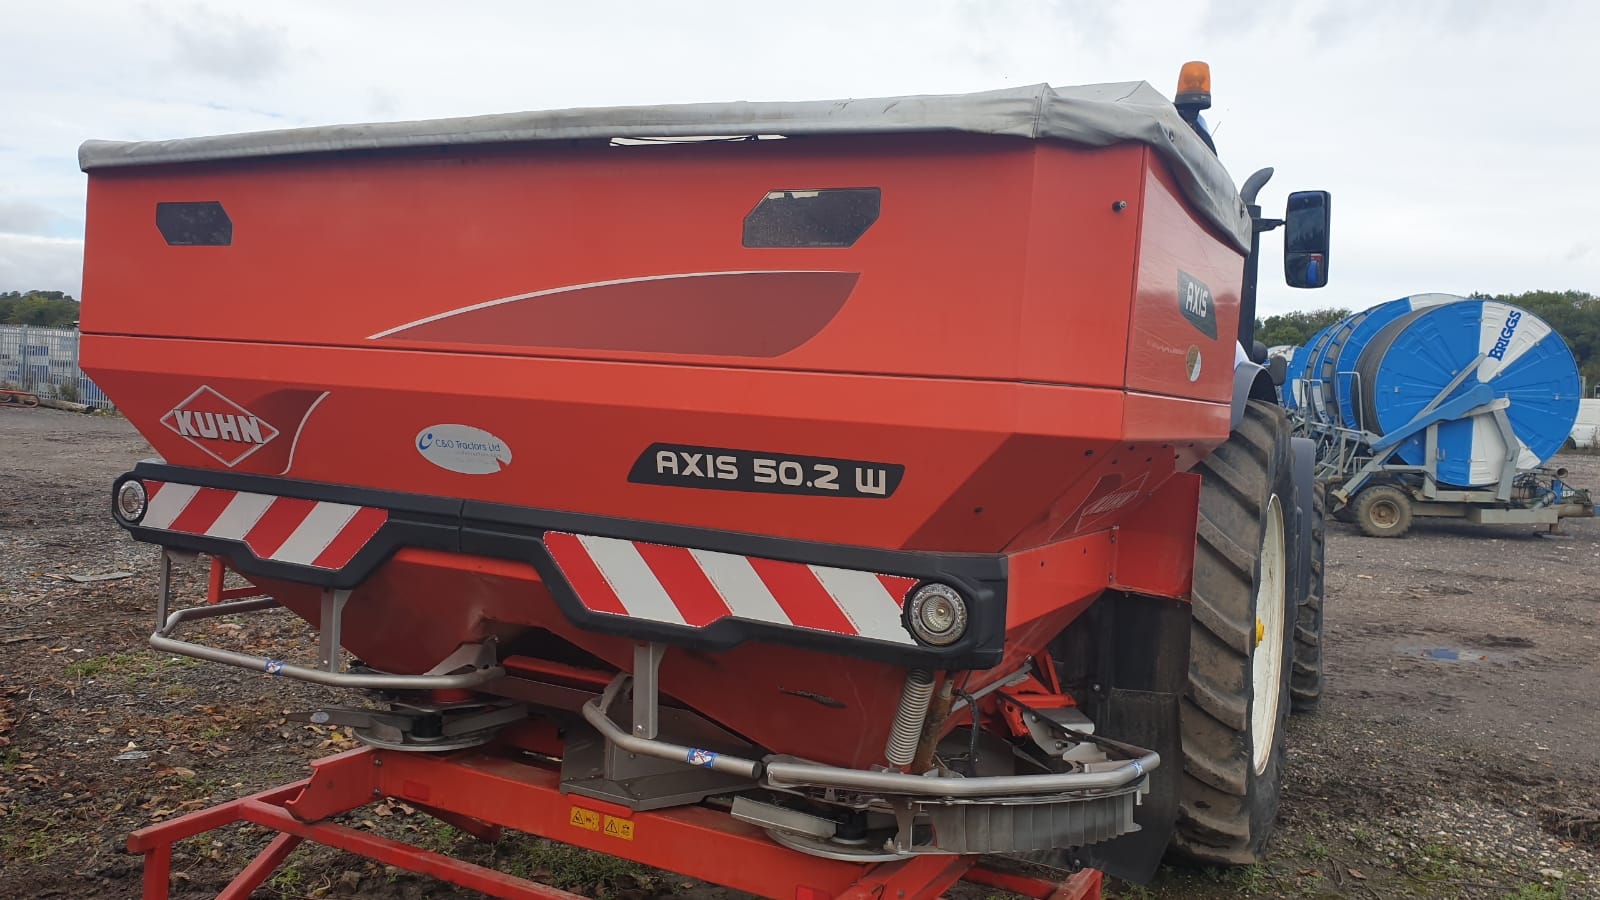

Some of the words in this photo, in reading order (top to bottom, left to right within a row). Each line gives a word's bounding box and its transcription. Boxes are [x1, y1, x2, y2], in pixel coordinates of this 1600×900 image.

[1185, 282, 1208, 318] AXIS
[1488, 310, 1522, 361] BRIGGS
[173, 408, 264, 444] KUHN
[455, 440, 487, 451] Tractors
[656, 451, 738, 480] AXIS
[753, 458, 840, 490] 50.2
[855, 467, 887, 495] W
